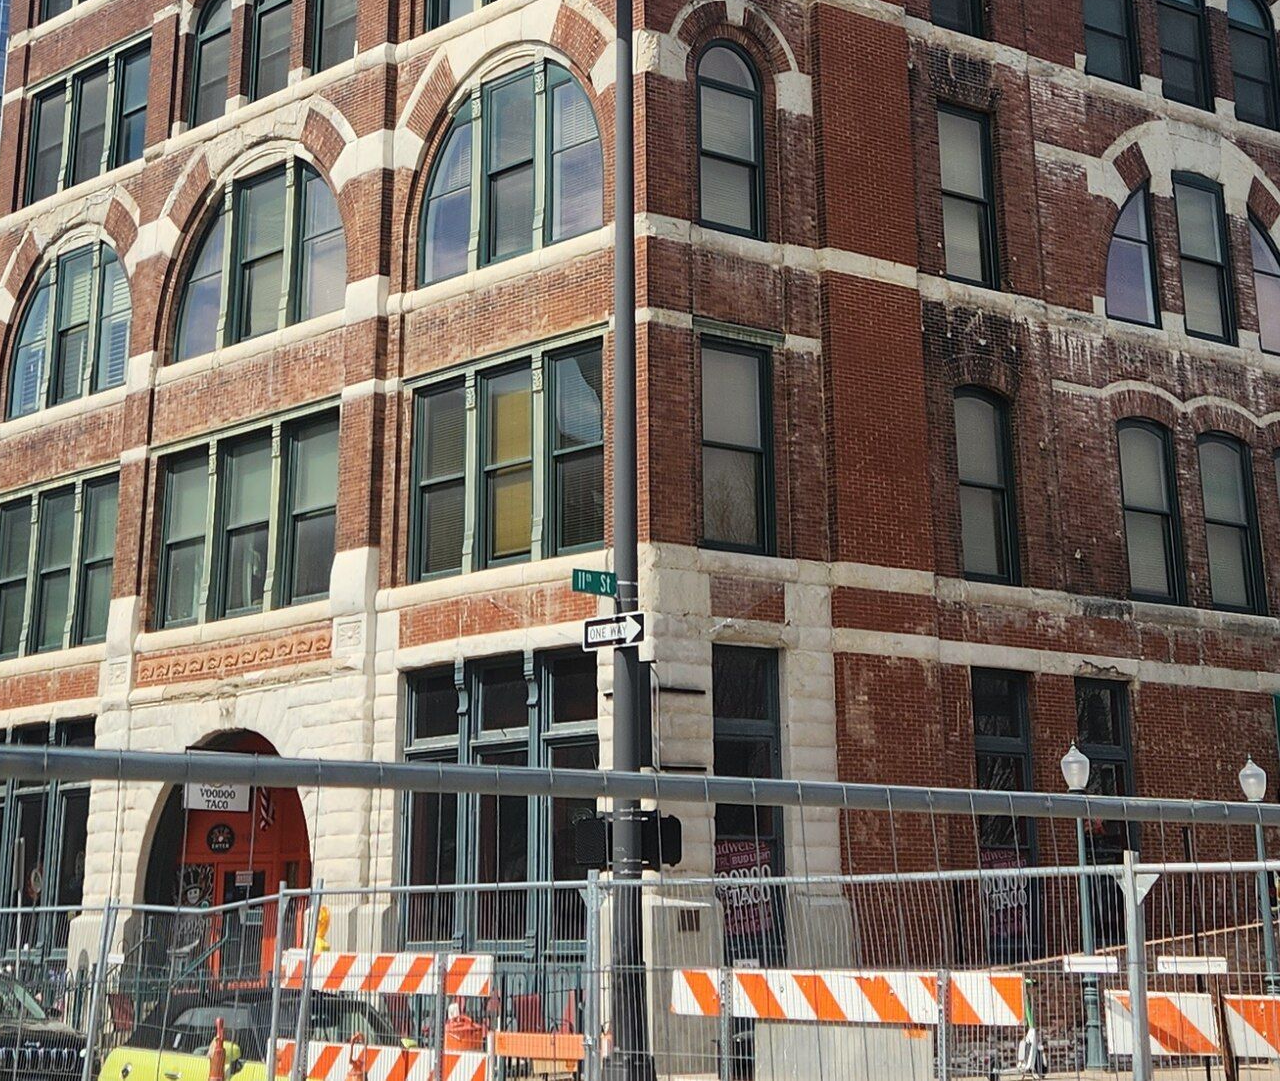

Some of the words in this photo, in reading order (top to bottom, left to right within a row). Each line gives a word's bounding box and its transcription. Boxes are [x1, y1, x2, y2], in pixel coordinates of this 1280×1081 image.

[600, 574, 611, 593] St
[589, 627, 606, 640] ONE
[610, 624, 627, 637] WAY
[200, 787, 236, 799] VOODOO
[205, 799, 229, 810] TACO
